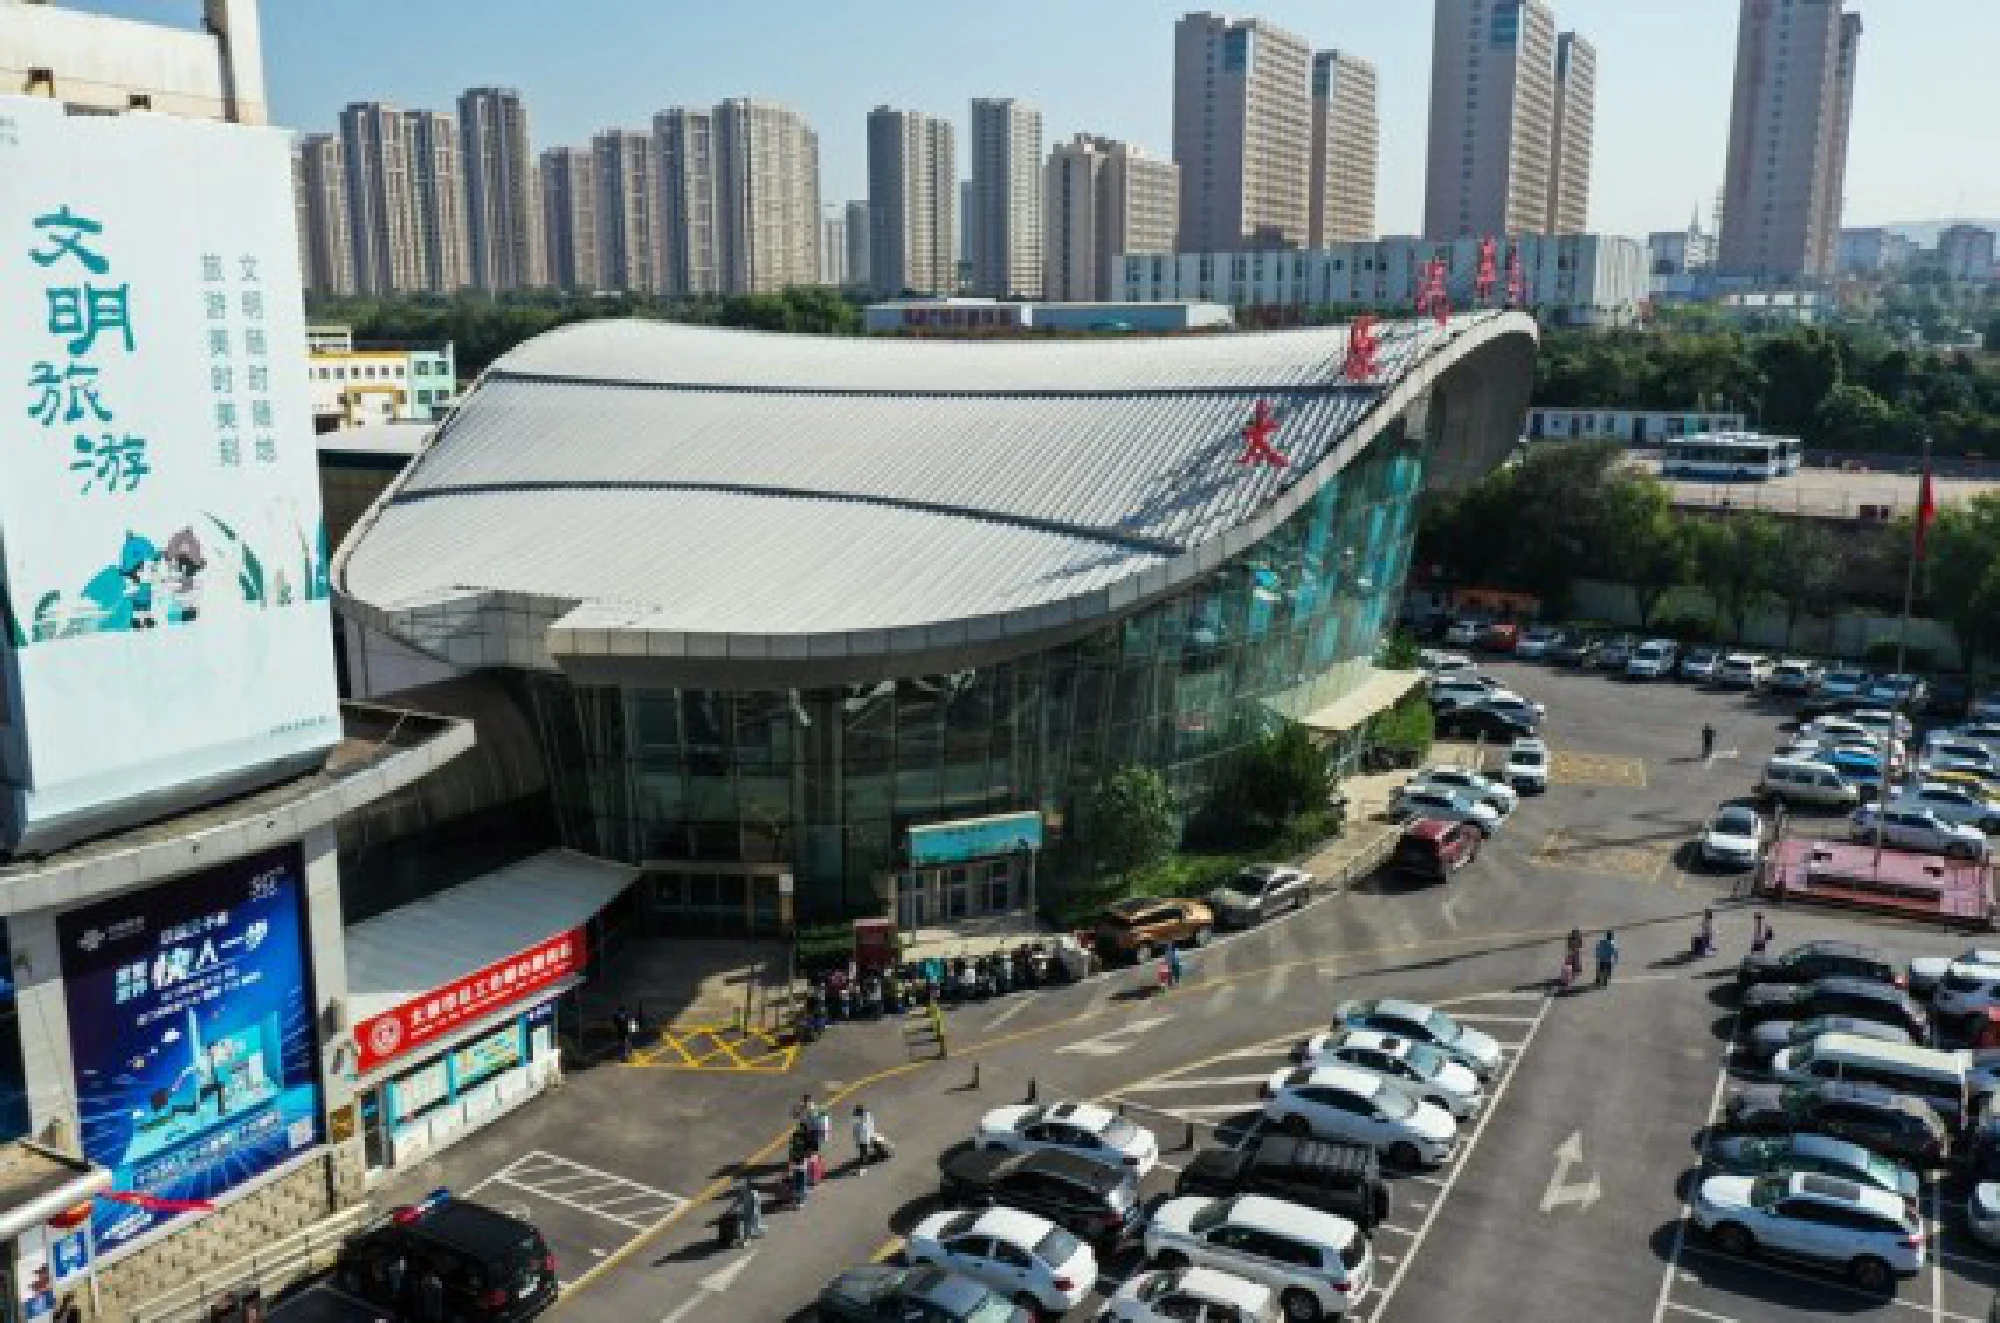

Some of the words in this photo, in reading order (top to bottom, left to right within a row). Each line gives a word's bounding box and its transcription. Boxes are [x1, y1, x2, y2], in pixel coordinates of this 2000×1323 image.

[27, 203, 151, 495] 文明旅游
[151, 917, 270, 991] 快人一步
